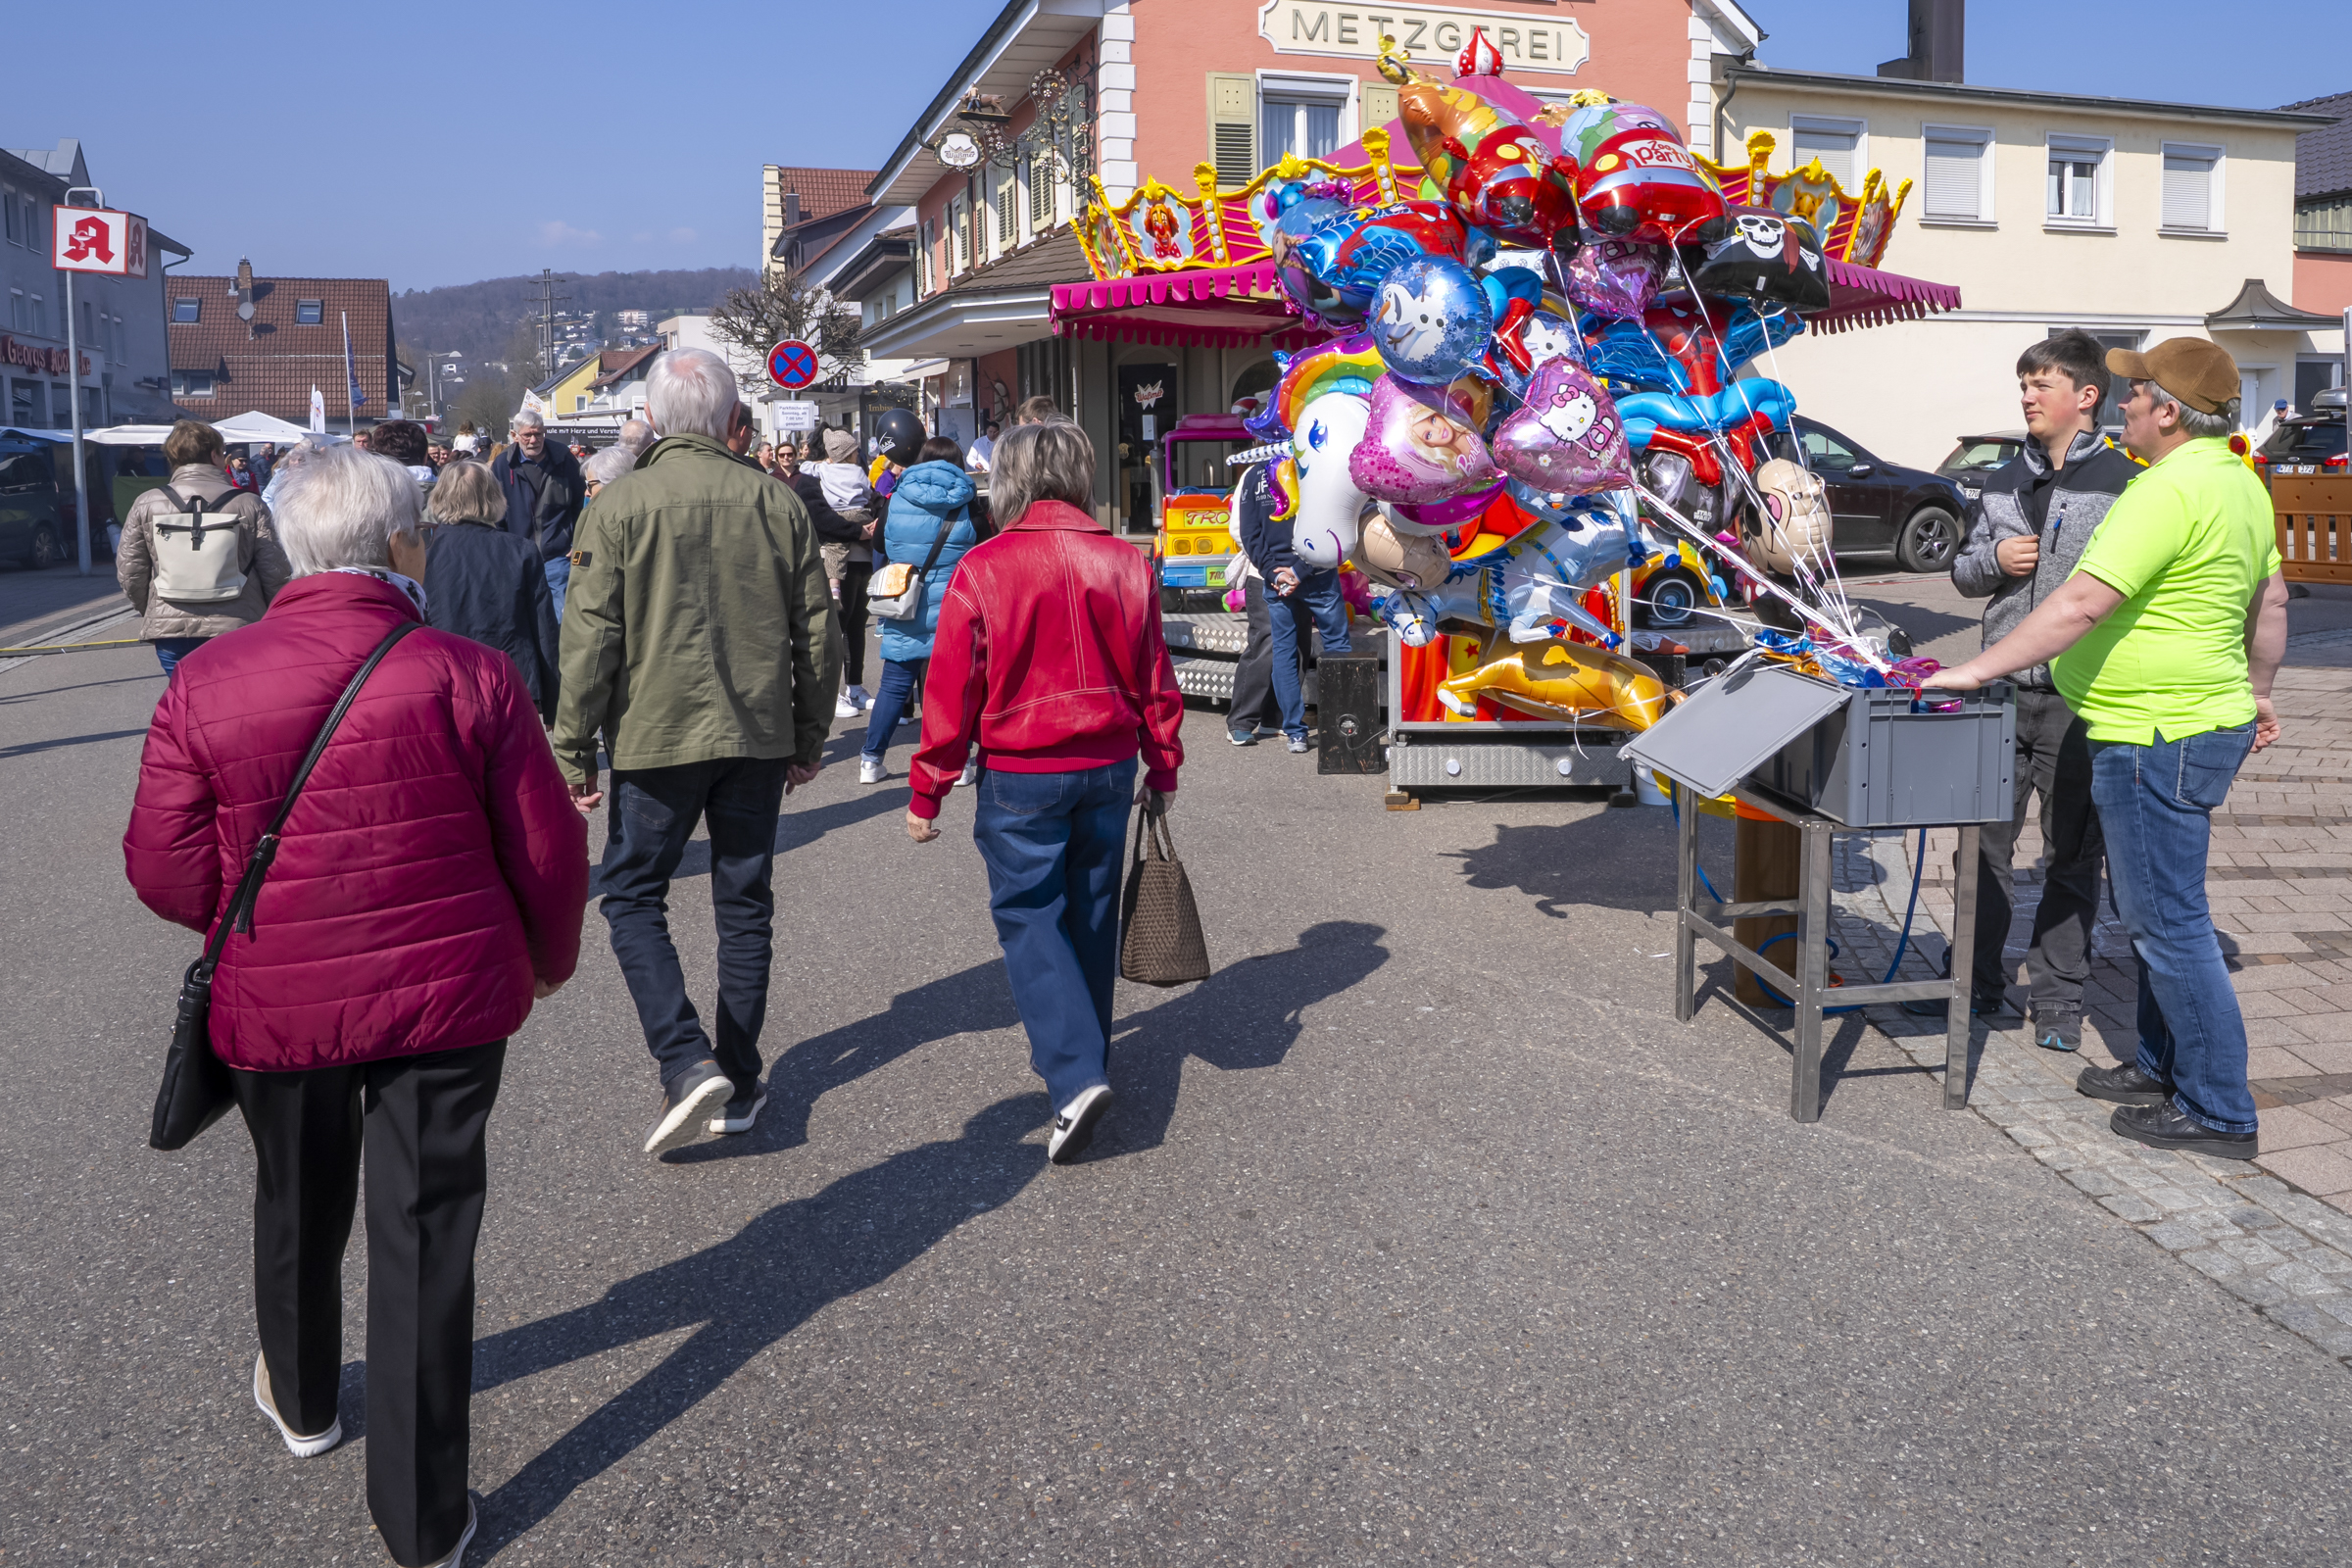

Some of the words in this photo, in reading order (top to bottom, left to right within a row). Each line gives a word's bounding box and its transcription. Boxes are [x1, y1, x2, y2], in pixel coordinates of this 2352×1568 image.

[1647, 140, 1672, 151] Zoo
[868, 404, 894, 413] Imbiss
[1693, 512, 1712, 521] WARS
[1696, 509, 1713, 517] STAR
